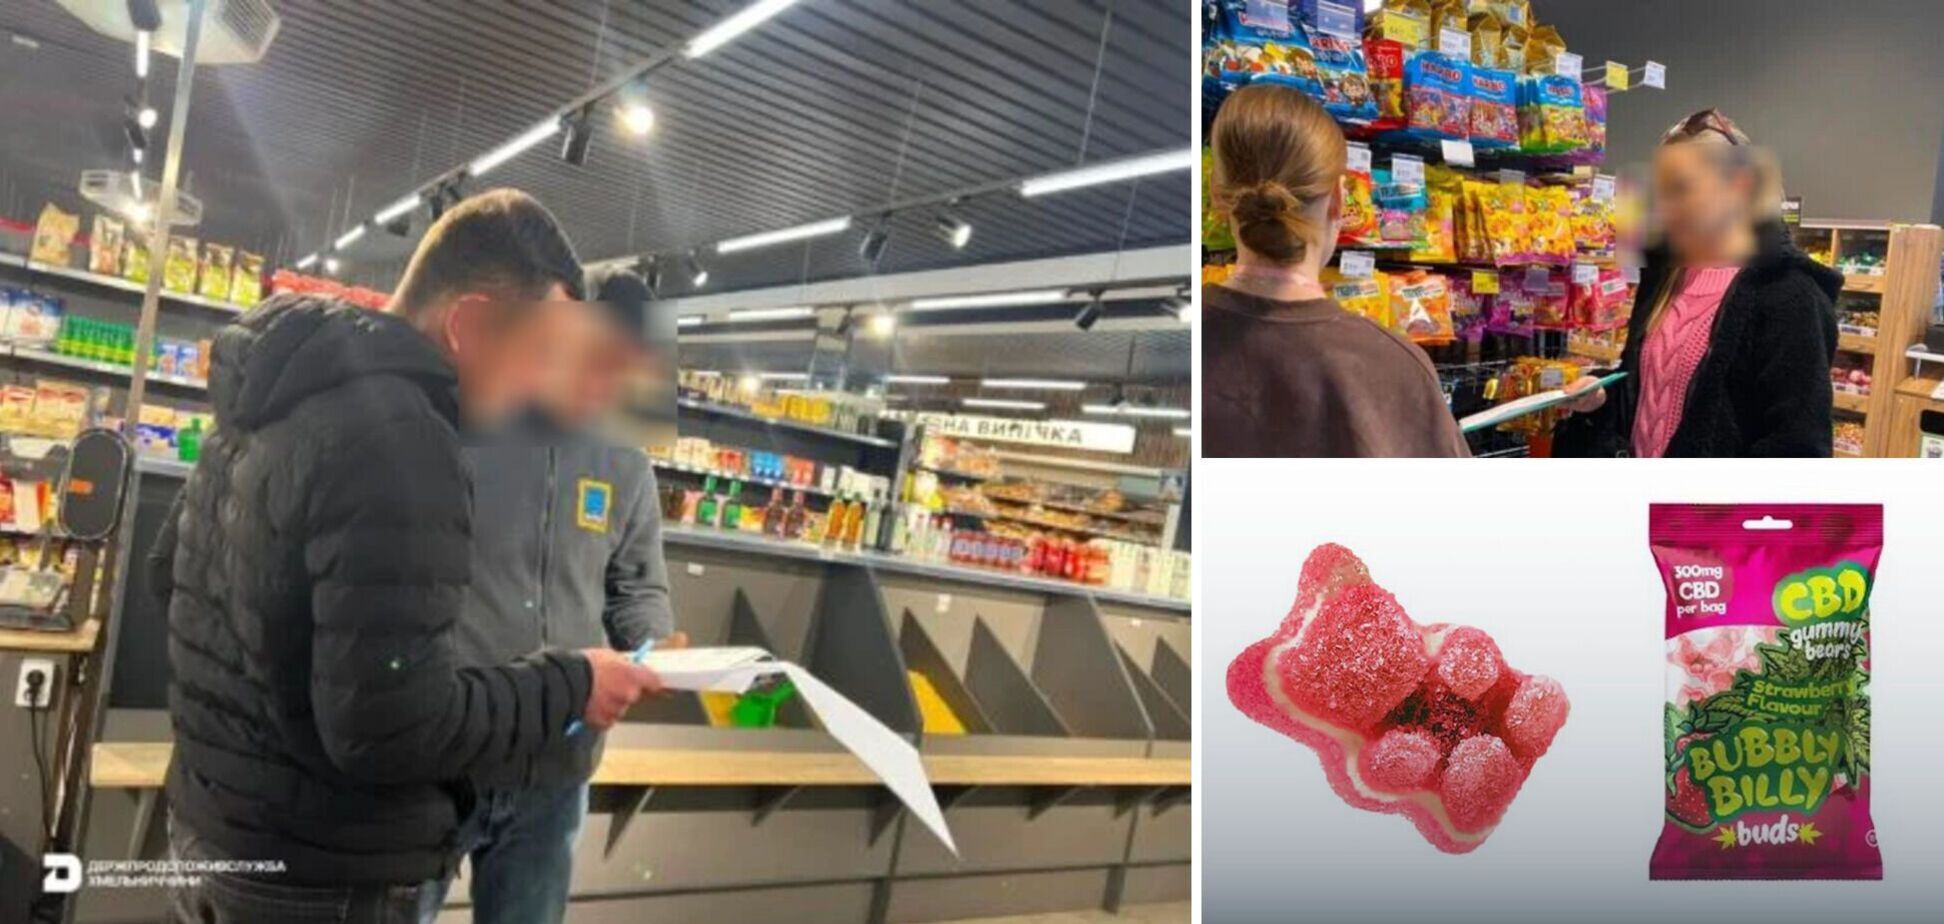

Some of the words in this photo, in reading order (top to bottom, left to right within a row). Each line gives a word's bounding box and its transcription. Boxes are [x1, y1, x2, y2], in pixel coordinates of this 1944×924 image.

[977, 421, 1083, 443] ВИПІЧКА
[1673, 564, 1723, 580] 300mg
[1679, 581, 1720, 600] CBD
[1781, 568, 1866, 620] CBD
[1676, 604, 1697, 619] per
[1700, 600, 1727, 615] bag
[1790, 620, 1862, 650] gummy
[1805, 640, 1851, 661] bears
[1752, 679, 1856, 698] Strawberry
[1747, 693, 1822, 715] Flavour
[1689, 726, 1839, 780] BUBBLY
[1707, 766, 1829, 817] BILLY
[1737, 813, 1799, 847] buds
